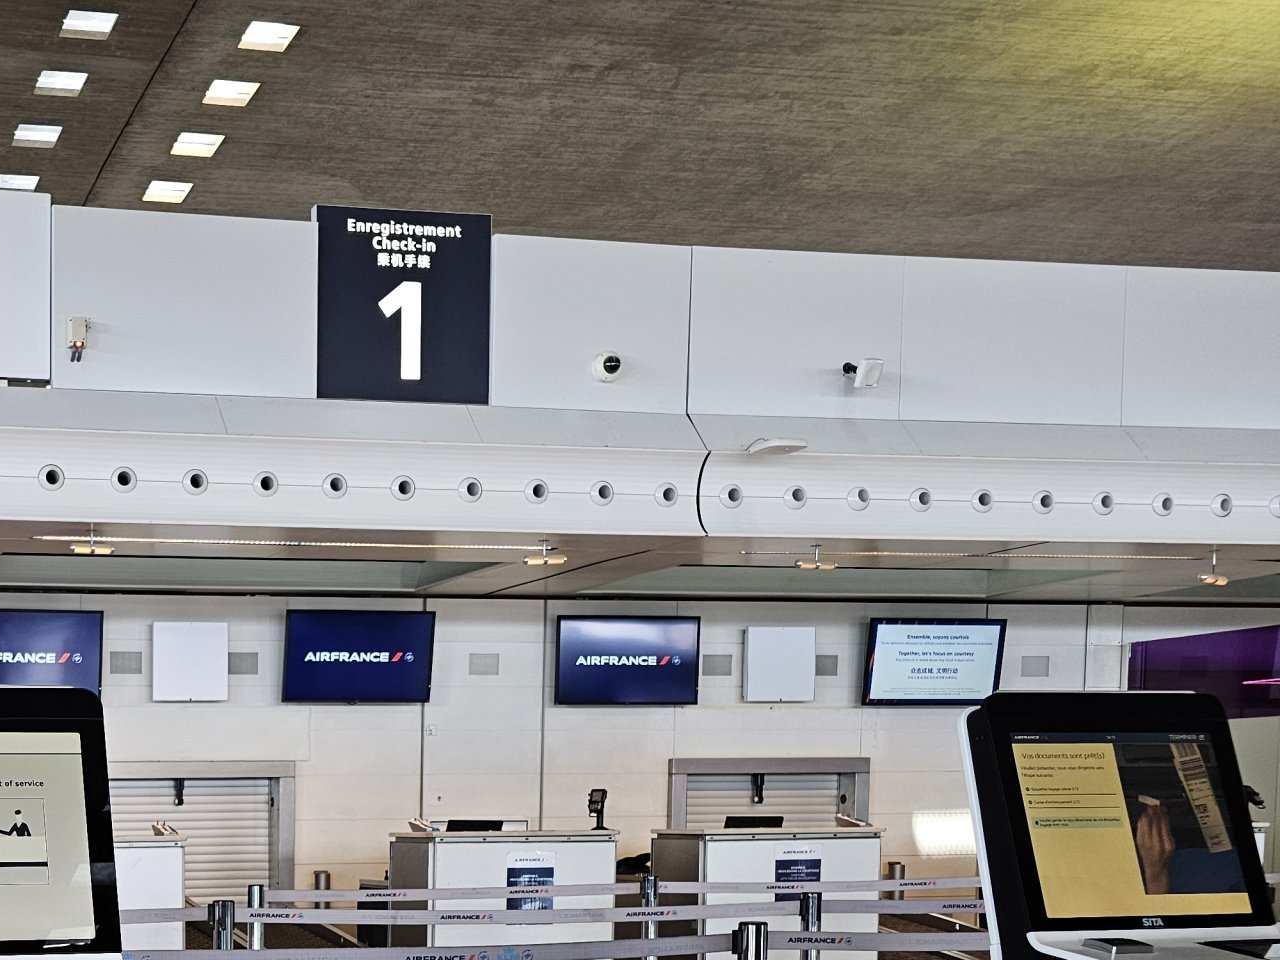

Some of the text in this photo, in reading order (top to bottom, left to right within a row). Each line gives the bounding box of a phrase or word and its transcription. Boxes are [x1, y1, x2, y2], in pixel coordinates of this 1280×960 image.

[347, 218, 462, 238] Enregistrement
[372, 237, 436, 252] Check-in
[378, 281, 422, 380] 1
[304, 651, 389, 663] AIRFRANCE
[575, 655, 657, 667] AIRFRANCE
[4, 780, 14, 788] of
[15, 780, 44, 788] service
[1142, 917, 1164, 926] SITA
